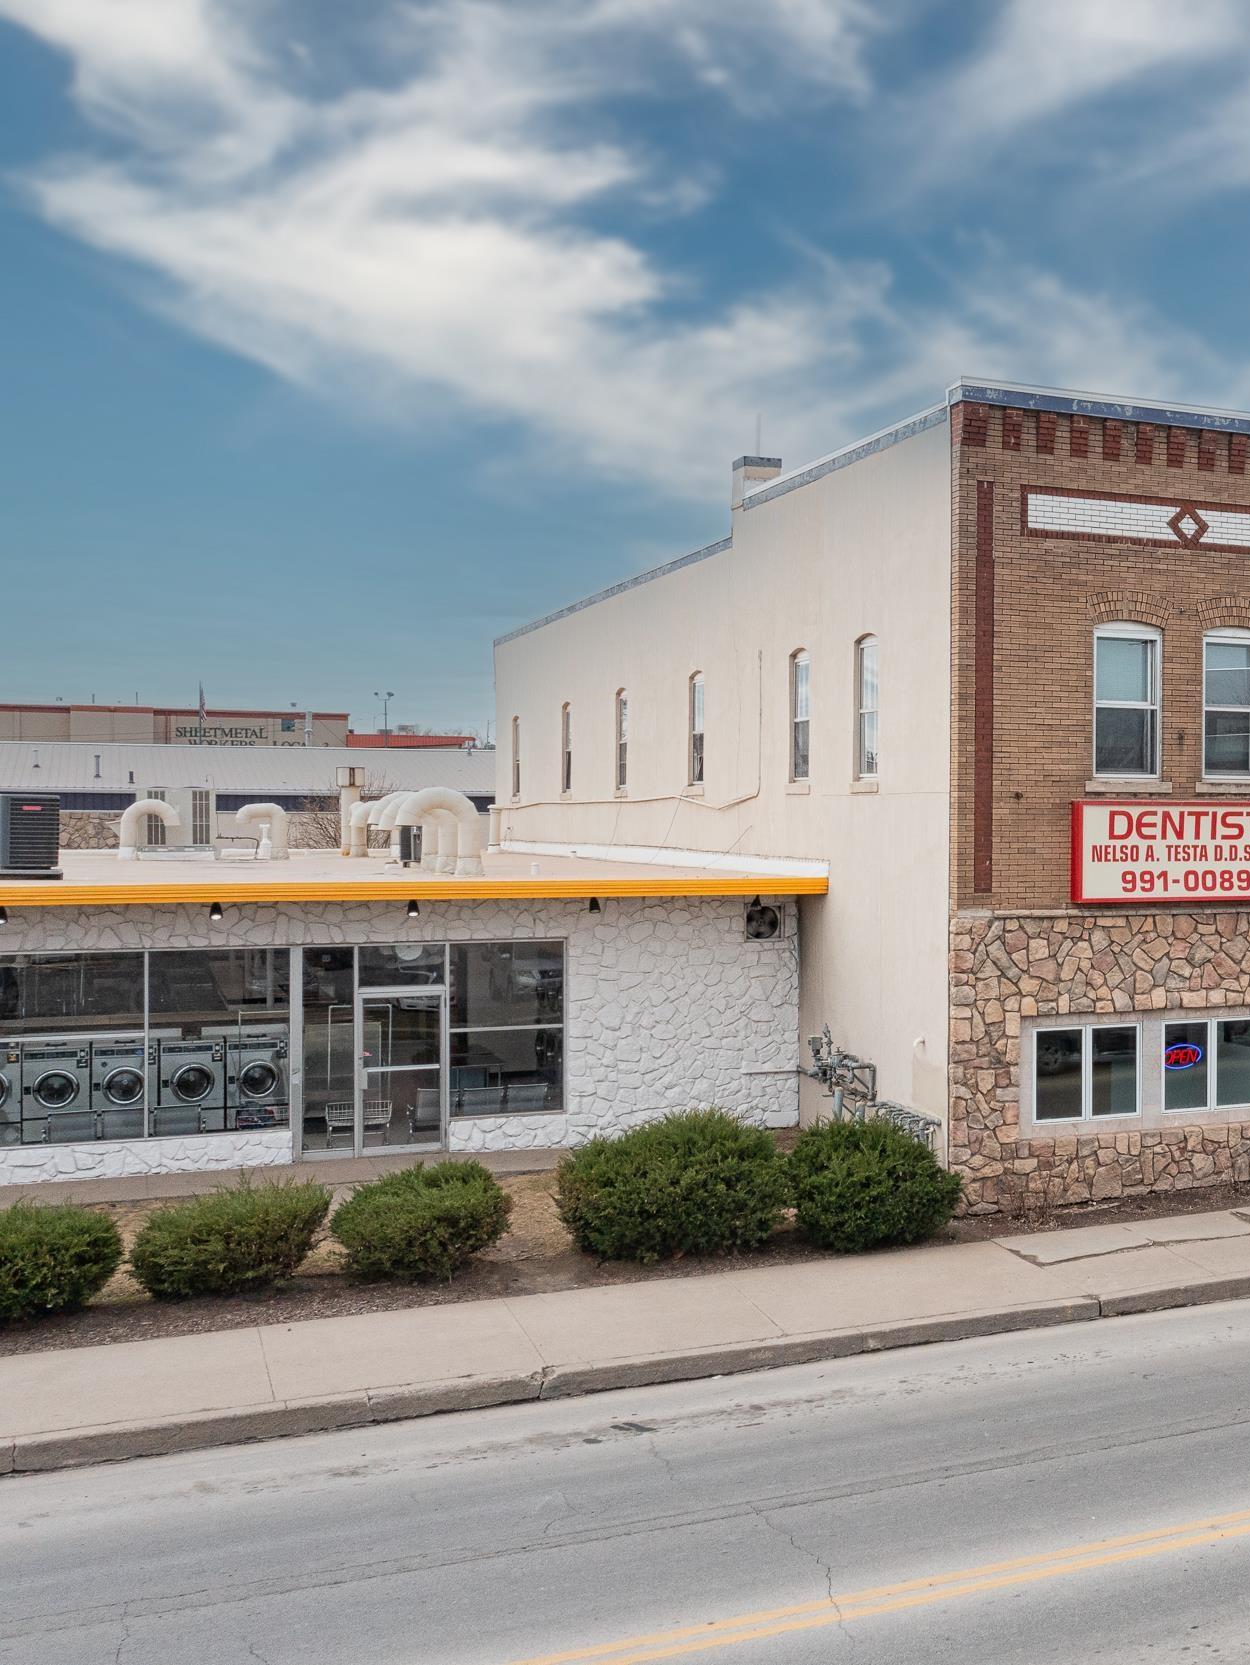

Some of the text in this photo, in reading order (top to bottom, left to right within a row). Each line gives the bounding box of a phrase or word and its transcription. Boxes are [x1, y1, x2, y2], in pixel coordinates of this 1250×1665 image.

[1091, 844, 1140, 863] NELSO
[1145, 844, 1160, 862] A.
[1166, 844, 1209, 862] TESTA
